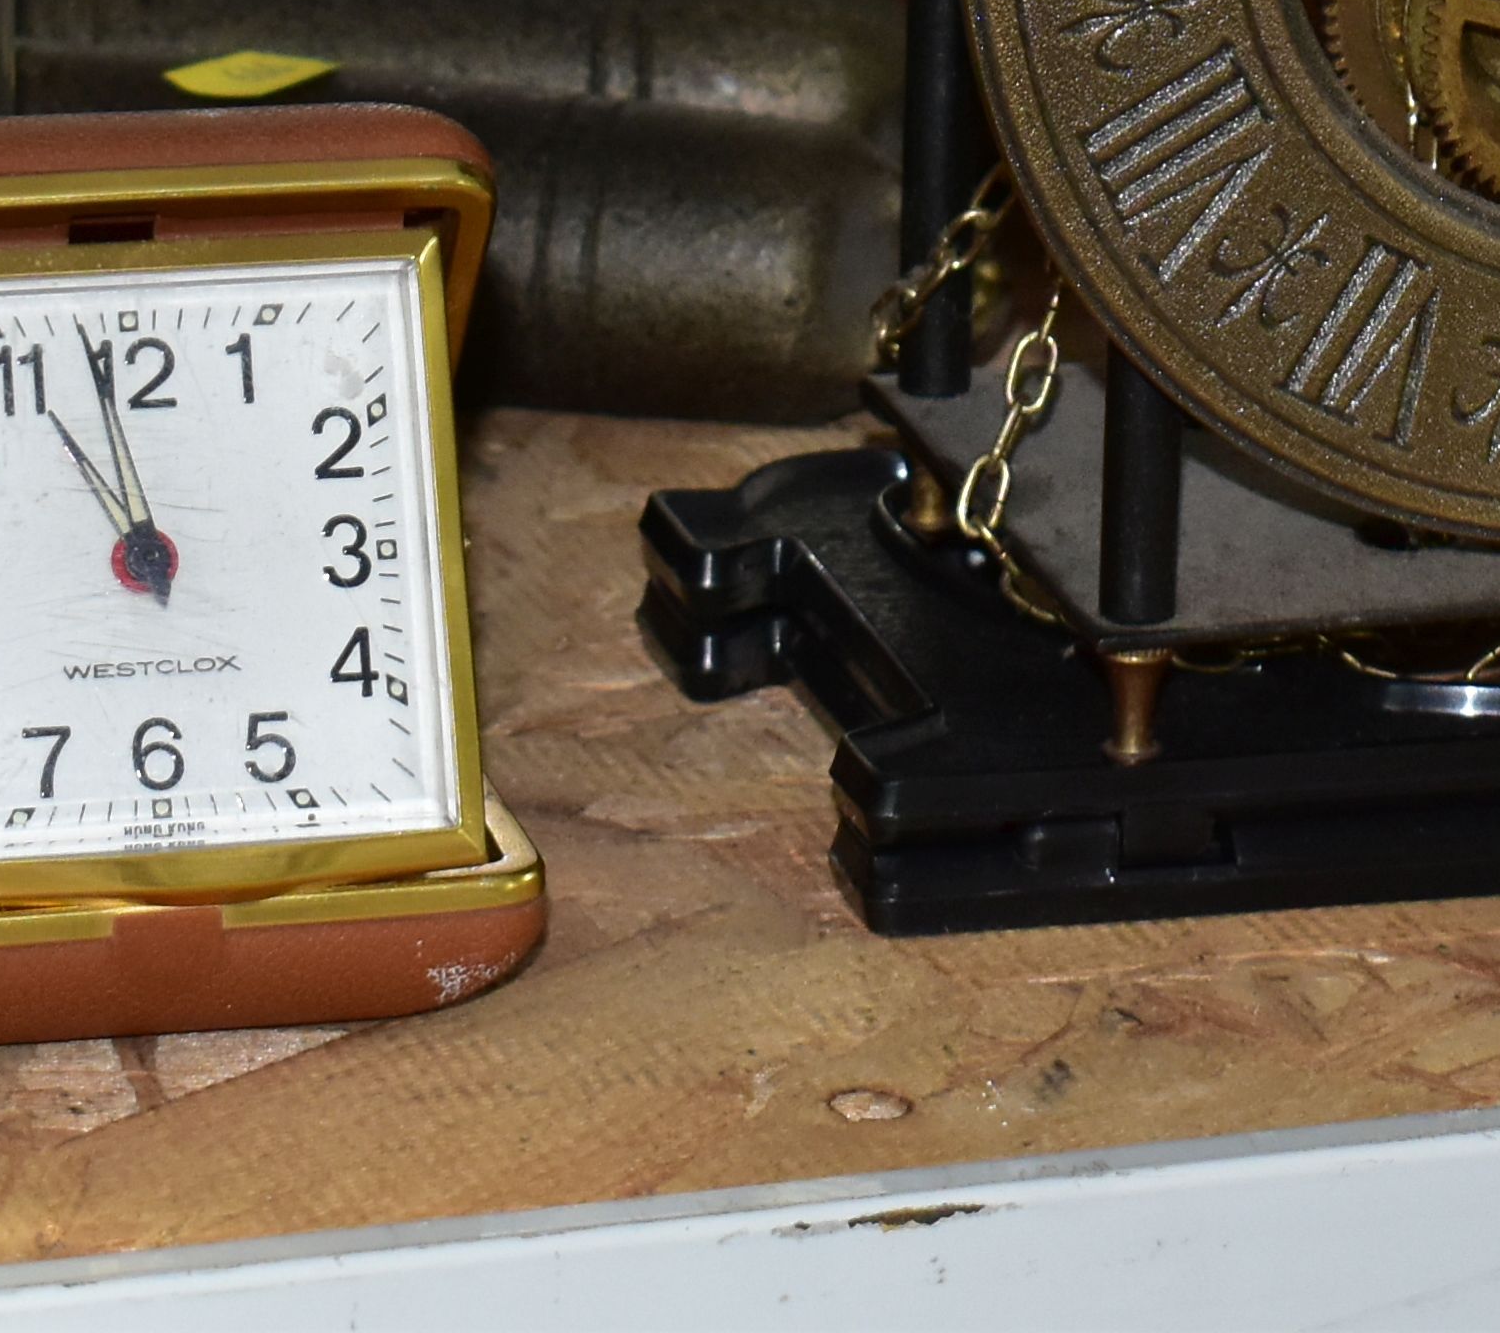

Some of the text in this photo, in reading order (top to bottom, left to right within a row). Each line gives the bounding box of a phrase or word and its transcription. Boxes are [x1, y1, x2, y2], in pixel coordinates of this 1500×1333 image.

[1088, 42, 1276, 285] VIII
[97, 337, 178, 411] 12
[226, 333, 254, 404] 1
[1278, 242, 1442, 450] VII
[311, 406, 365, 480] 2
[322, 513, 373, 589] 3
[63, 654, 243, 680] WESTCLOX
[329, 626, 380, 699] 4
[22, 725, 72, 800] 7
[132, 716, 185, 792] 6
[244, 710, 297, 783] 5
